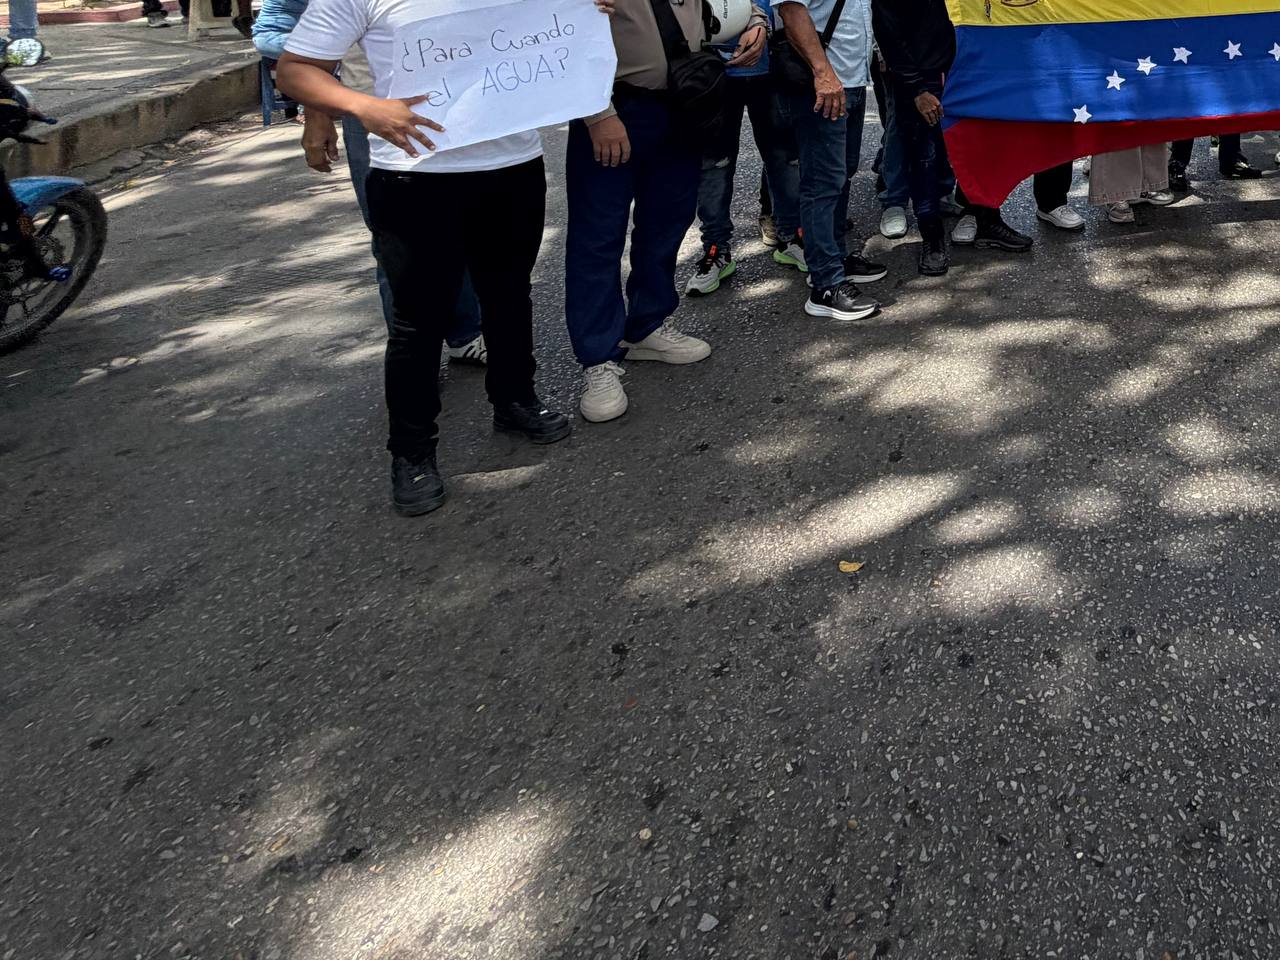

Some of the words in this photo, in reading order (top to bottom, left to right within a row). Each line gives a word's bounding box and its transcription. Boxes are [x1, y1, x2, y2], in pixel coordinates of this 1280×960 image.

[401, 38, 473, 72] ¿Para
[491, 14, 575, 52] Cuando
[426, 78, 452, 107] el
[482, 47, 570, 96] AGUA?
